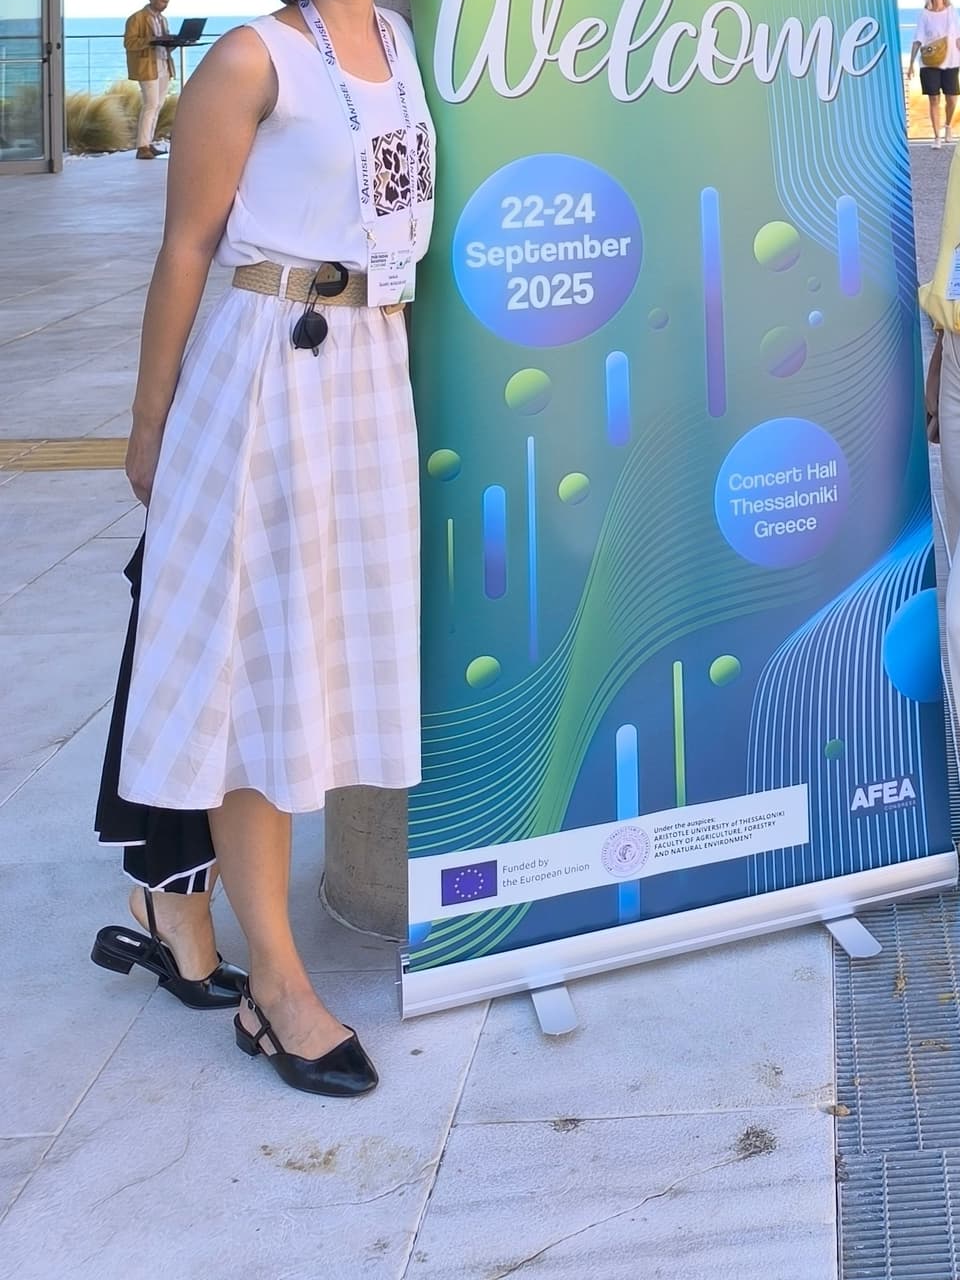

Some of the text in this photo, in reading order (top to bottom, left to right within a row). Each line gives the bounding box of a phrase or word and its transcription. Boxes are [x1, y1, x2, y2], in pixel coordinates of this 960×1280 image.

[314, 18, 336, 60] ANTISEL
[339, 82, 361, 124] ANTISEL
[360, 148, 370, 198] ANTISEL
[501, 192, 596, 229] 22-24
[465, 234, 632, 272] September
[507, 272, 595, 311] 2025
[729, 460, 837, 491] Concert Hall
[729, 484, 838, 516] Thessaloniki
[754, 516, 817, 538] Greece
[851, 777, 916, 811] AFEA
[654, 810, 785, 842] ARISTOTLE UNIVERSITY of THESSALONIKI
[654, 824, 673, 834] Under
[674, 822, 686, 830] the
[654, 839, 683, 850] FACULTY
[685, 836, 694, 844] OF
[744, 821, 776, 832] FORESTRY
[654, 833, 752, 858] AND NATURAL ENVIRONMENT
[502, 858, 550, 874] Funded by
[502, 863, 590, 888] the European Union
